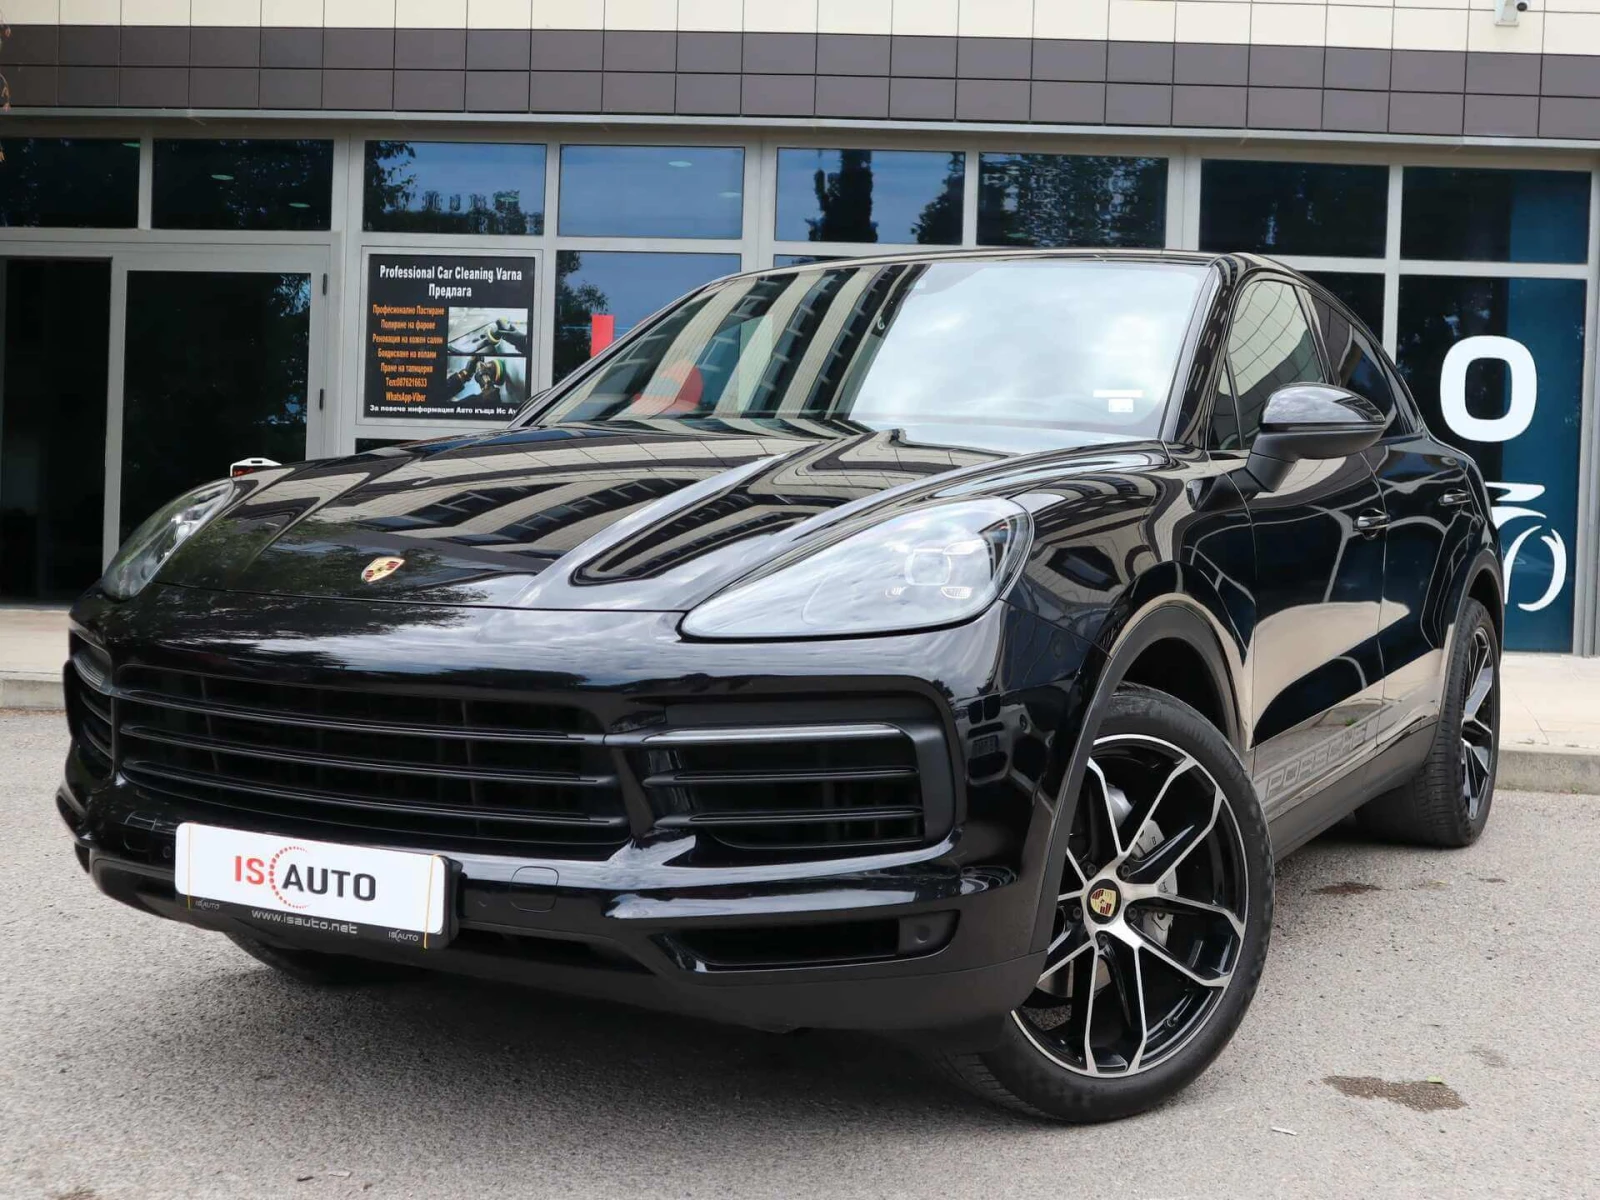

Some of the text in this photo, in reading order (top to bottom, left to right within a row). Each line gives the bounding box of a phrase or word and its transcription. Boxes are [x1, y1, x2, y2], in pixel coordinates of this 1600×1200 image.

[380, 265, 522, 283] Professional Car Cleaning Varna
[428, 283, 472, 299] Предлага
[407, 321, 415, 329] на
[407, 405, 455, 414] информация
[456, 406, 473, 414] Авто
[474, 407, 495, 415] къща
[234, 855, 377, 902] IS AUTO
[251, 909, 358, 934] www.isauto.net
[397, 932, 419, 942] AUTO
